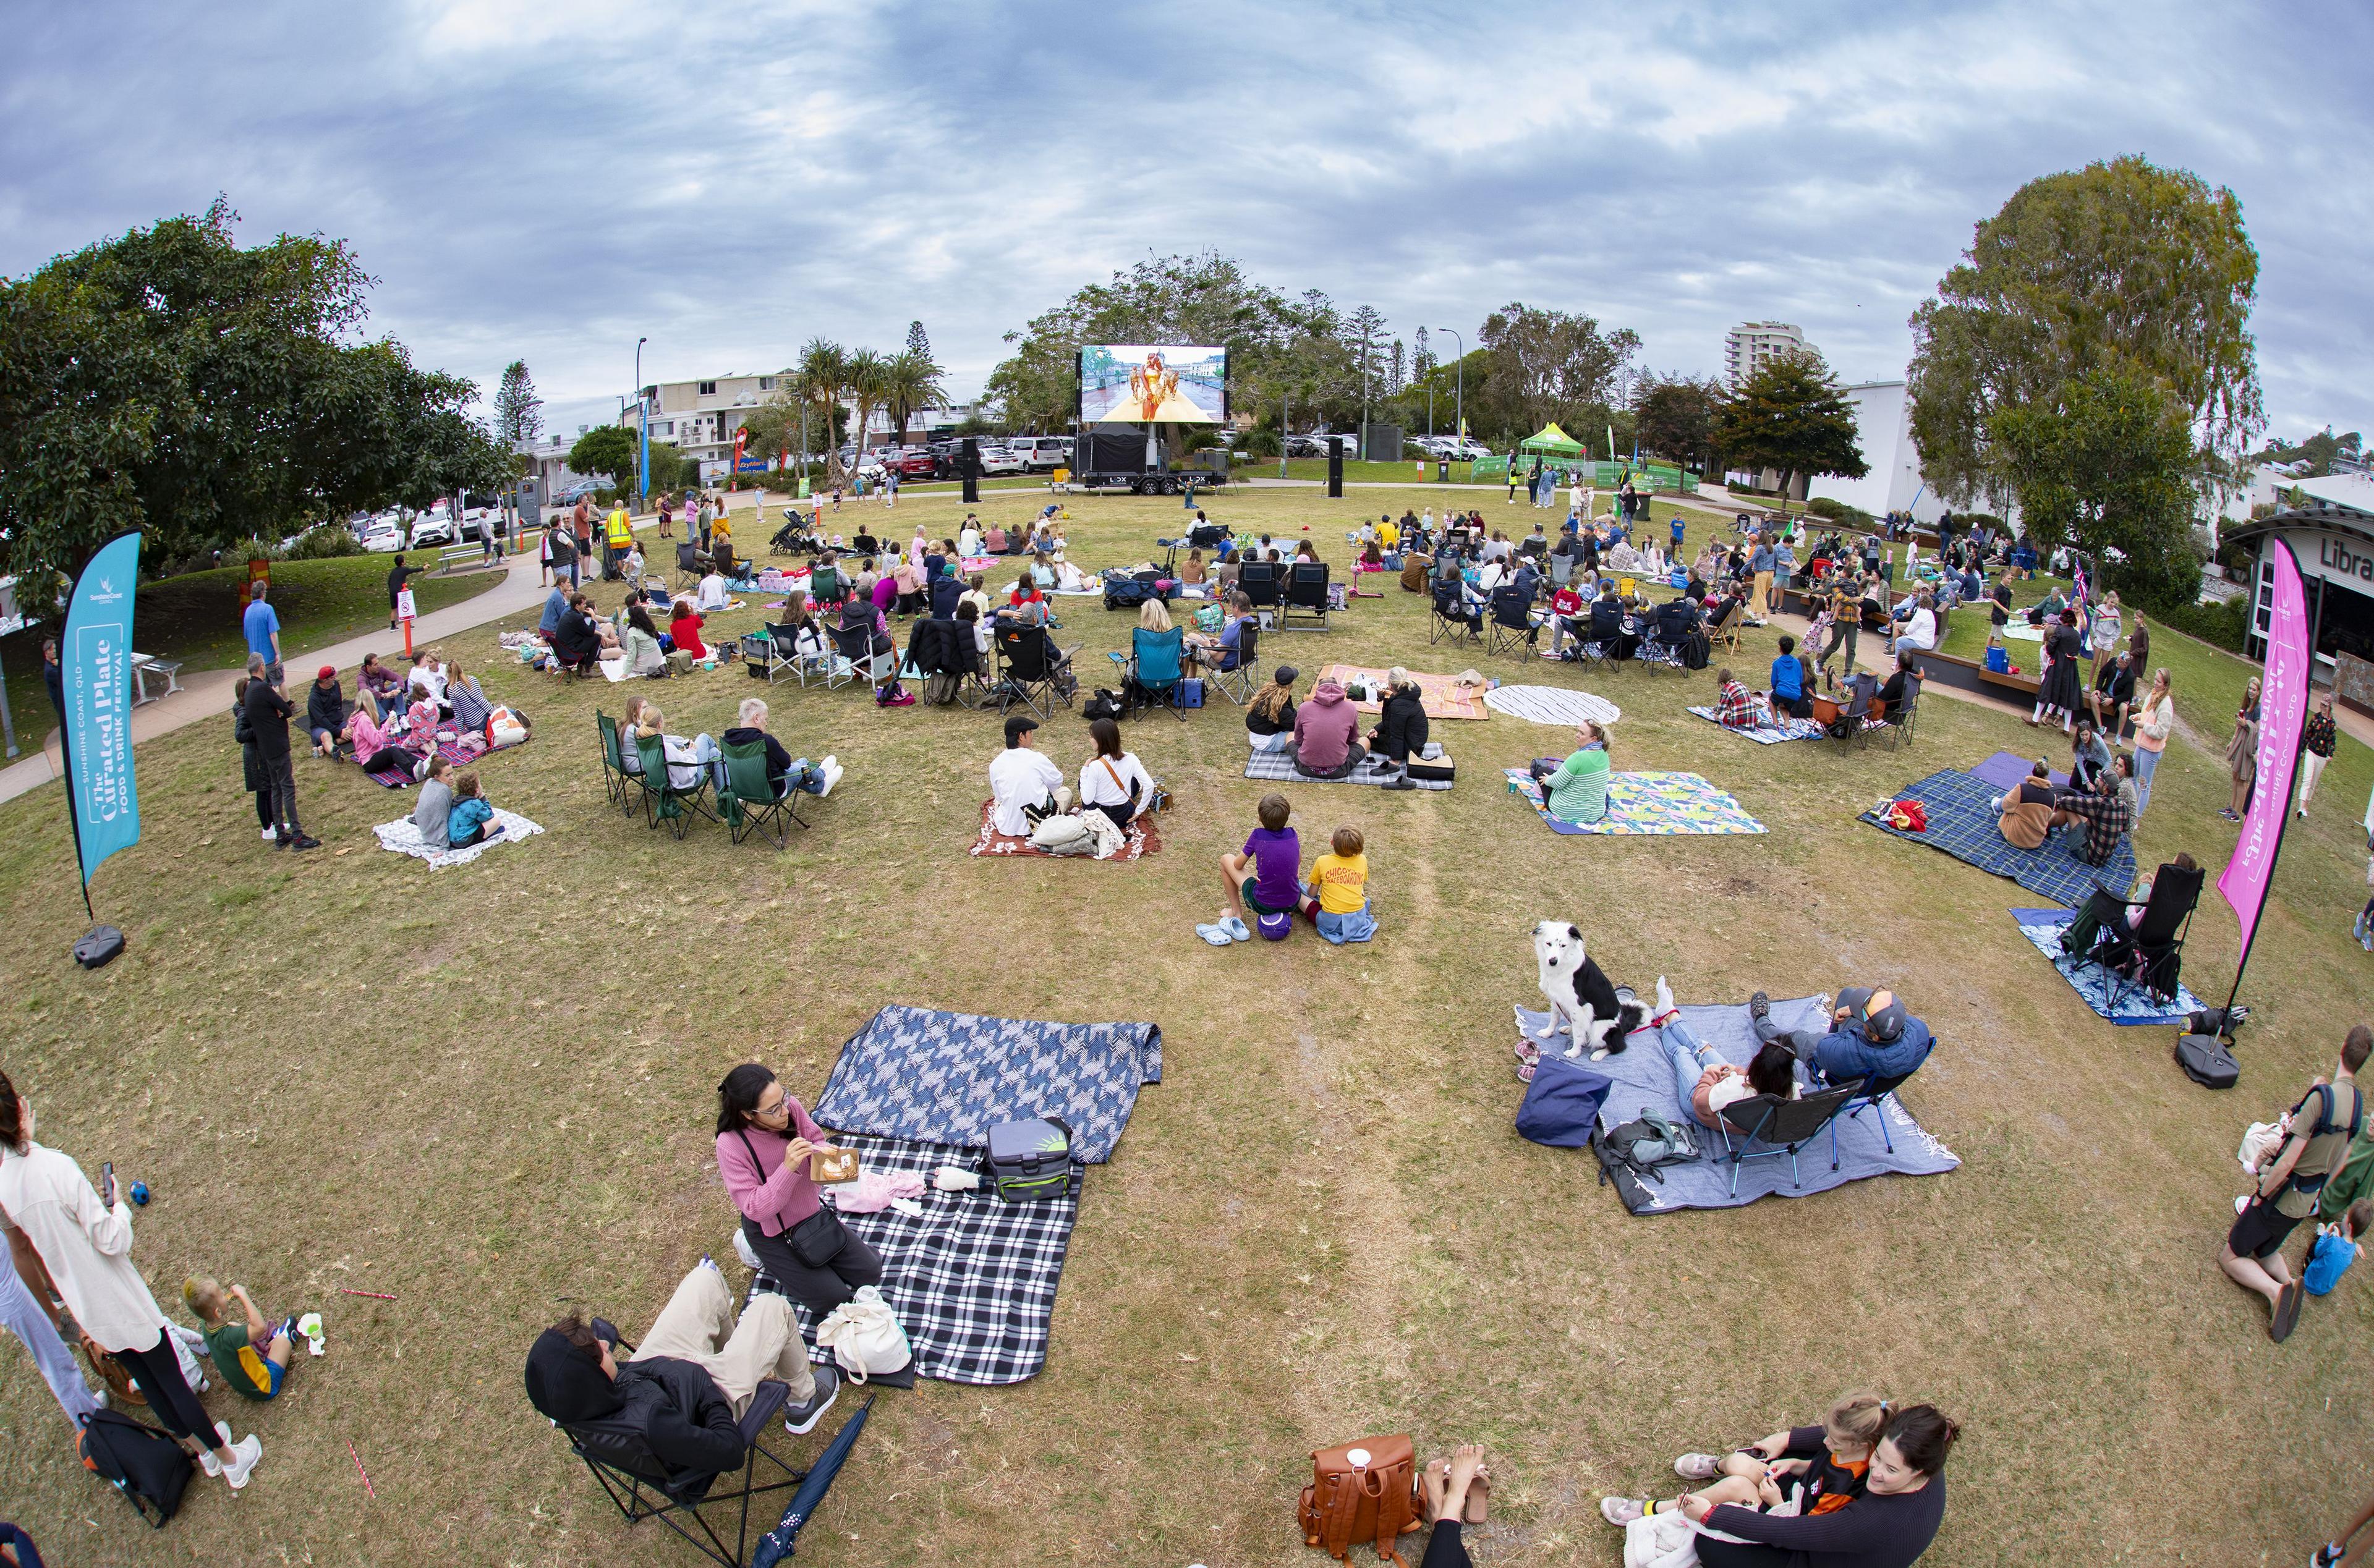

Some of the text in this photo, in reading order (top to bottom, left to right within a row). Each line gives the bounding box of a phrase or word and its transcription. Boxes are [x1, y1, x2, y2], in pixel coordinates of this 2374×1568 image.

[75, 666, 89, 783] SUNSHINE COAST, QLD
[93, 639, 117, 821] Curated Plate
[93, 772, 104, 806] The
[114, 648, 129, 814] FOOD & DRINK FESTIVAL
